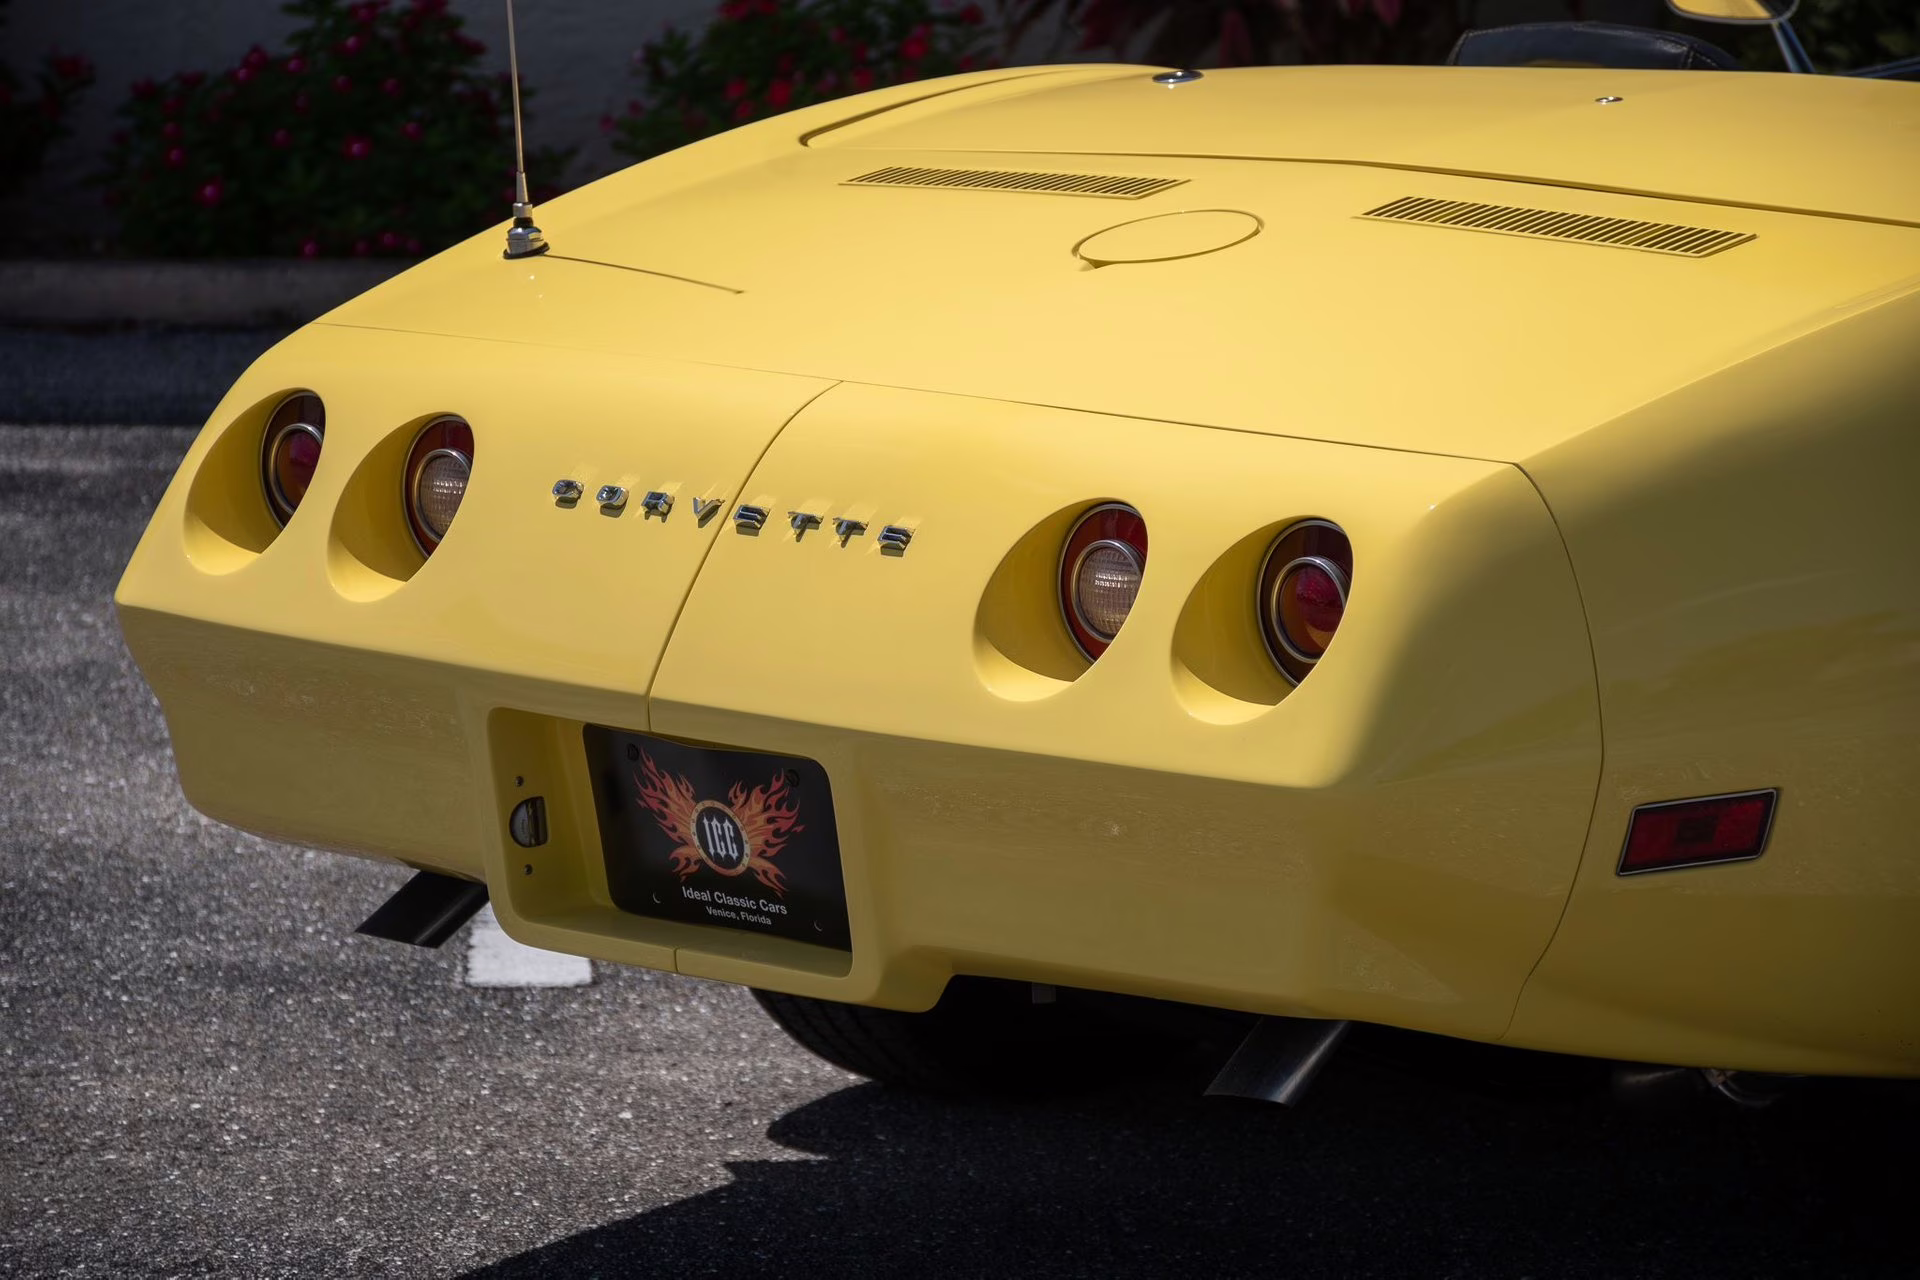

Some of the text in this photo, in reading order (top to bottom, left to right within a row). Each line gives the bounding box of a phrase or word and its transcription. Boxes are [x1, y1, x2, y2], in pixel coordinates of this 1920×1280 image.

[552, 478, 916, 557] CORVETTE
[702, 815, 738, 860] ICC
[682, 886, 788, 915] Ideal Classic Cars
[706, 906, 772, 925] Venice, Florida
